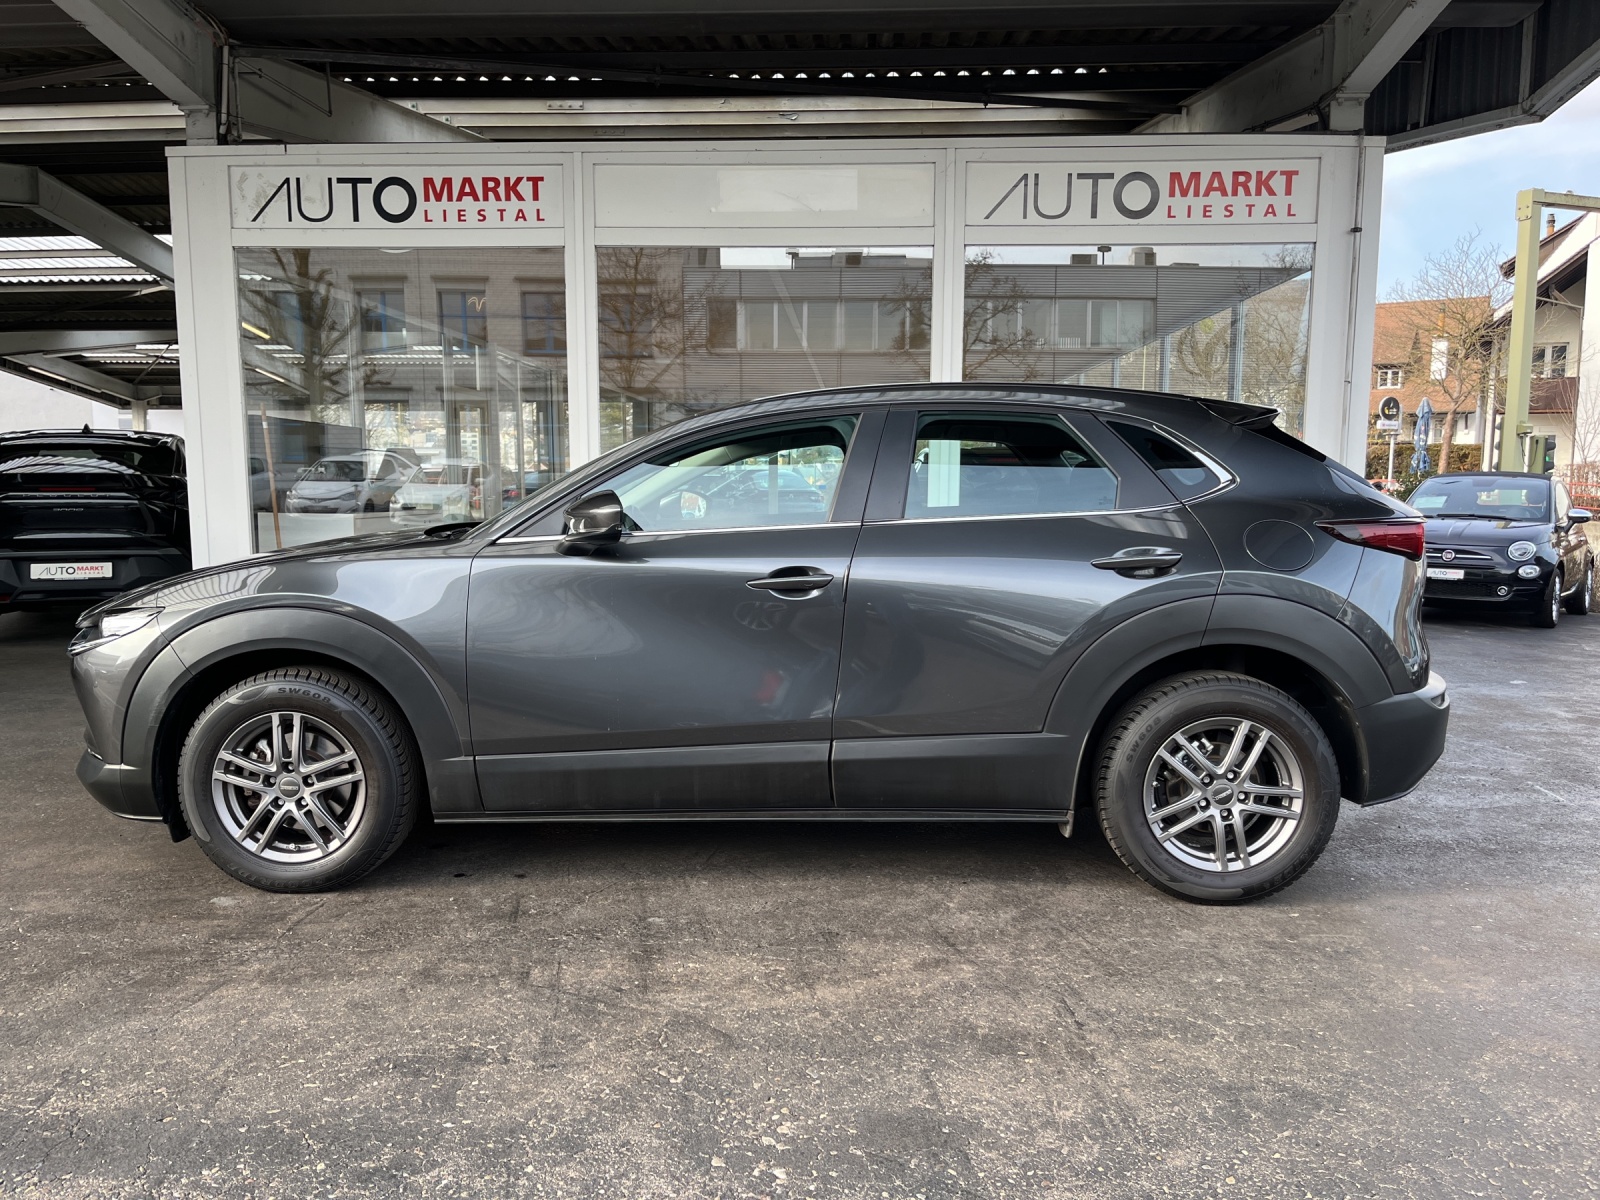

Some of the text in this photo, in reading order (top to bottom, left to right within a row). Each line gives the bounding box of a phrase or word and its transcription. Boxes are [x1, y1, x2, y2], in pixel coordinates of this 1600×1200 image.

[251, 176, 545, 223] AUTO MARKT
[983, 170, 1299, 220] AUTO MARKT
[423, 208, 545, 223] LIESTAL
[1167, 203, 1297, 219] LIESTAL
[39, 566, 76, 576] AUTO
[277, 687, 332, 704] SW608
